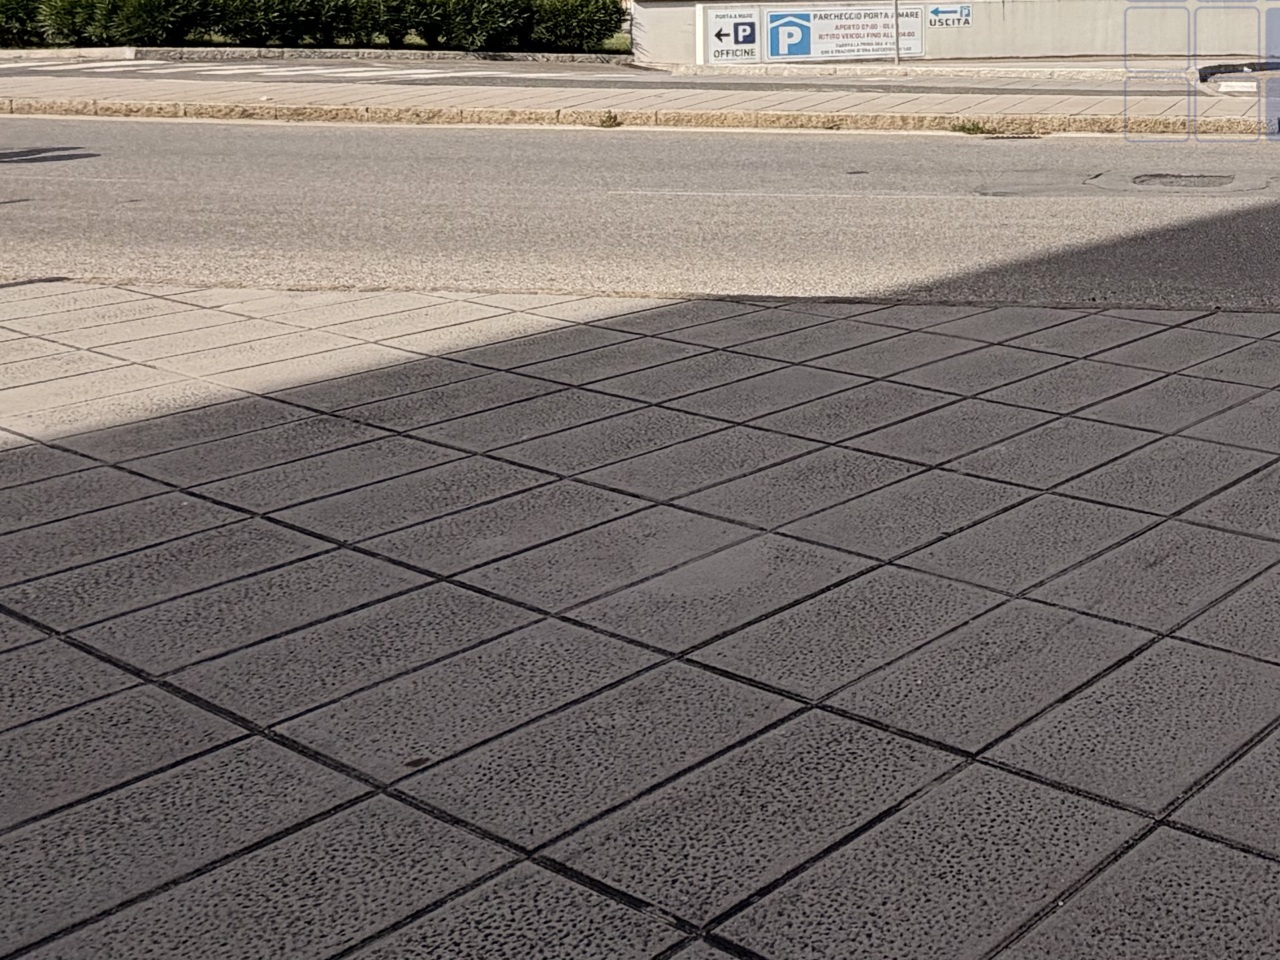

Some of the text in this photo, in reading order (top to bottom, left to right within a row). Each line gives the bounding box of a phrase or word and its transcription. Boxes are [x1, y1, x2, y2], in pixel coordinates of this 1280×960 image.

[929, 18, 970, 26] USCITA
[778, 26, 802, 54] P
[714, 48, 757, 58] OFFICINE
